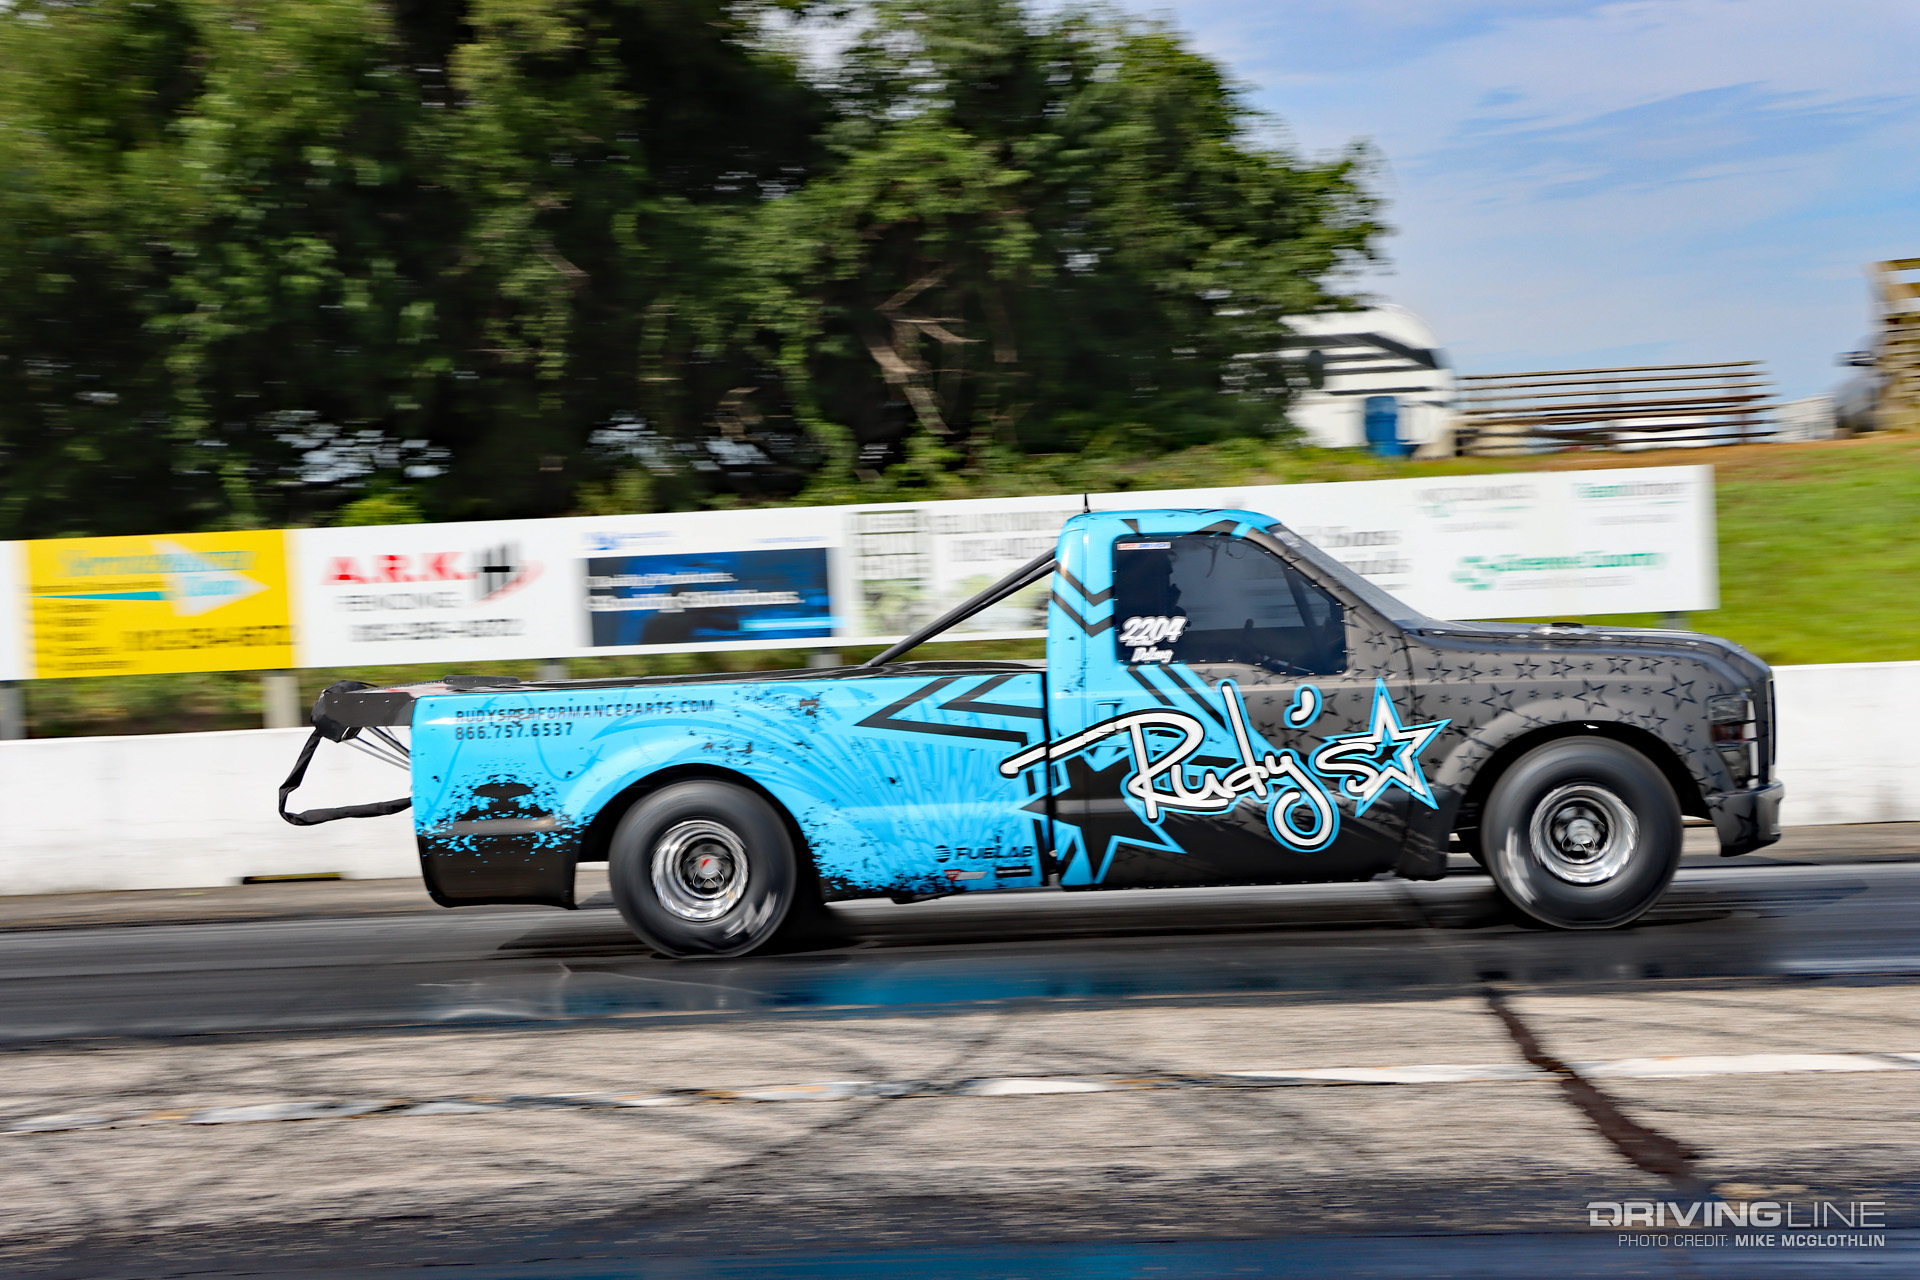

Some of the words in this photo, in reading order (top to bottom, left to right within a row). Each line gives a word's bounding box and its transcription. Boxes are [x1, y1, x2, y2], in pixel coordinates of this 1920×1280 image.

[1118, 615, 1188, 643] 2204
[455, 722, 573, 740] 866.757.6537
[999, 681, 1405, 849] Rudy's
[955, 845, 1034, 860] FUELAB
